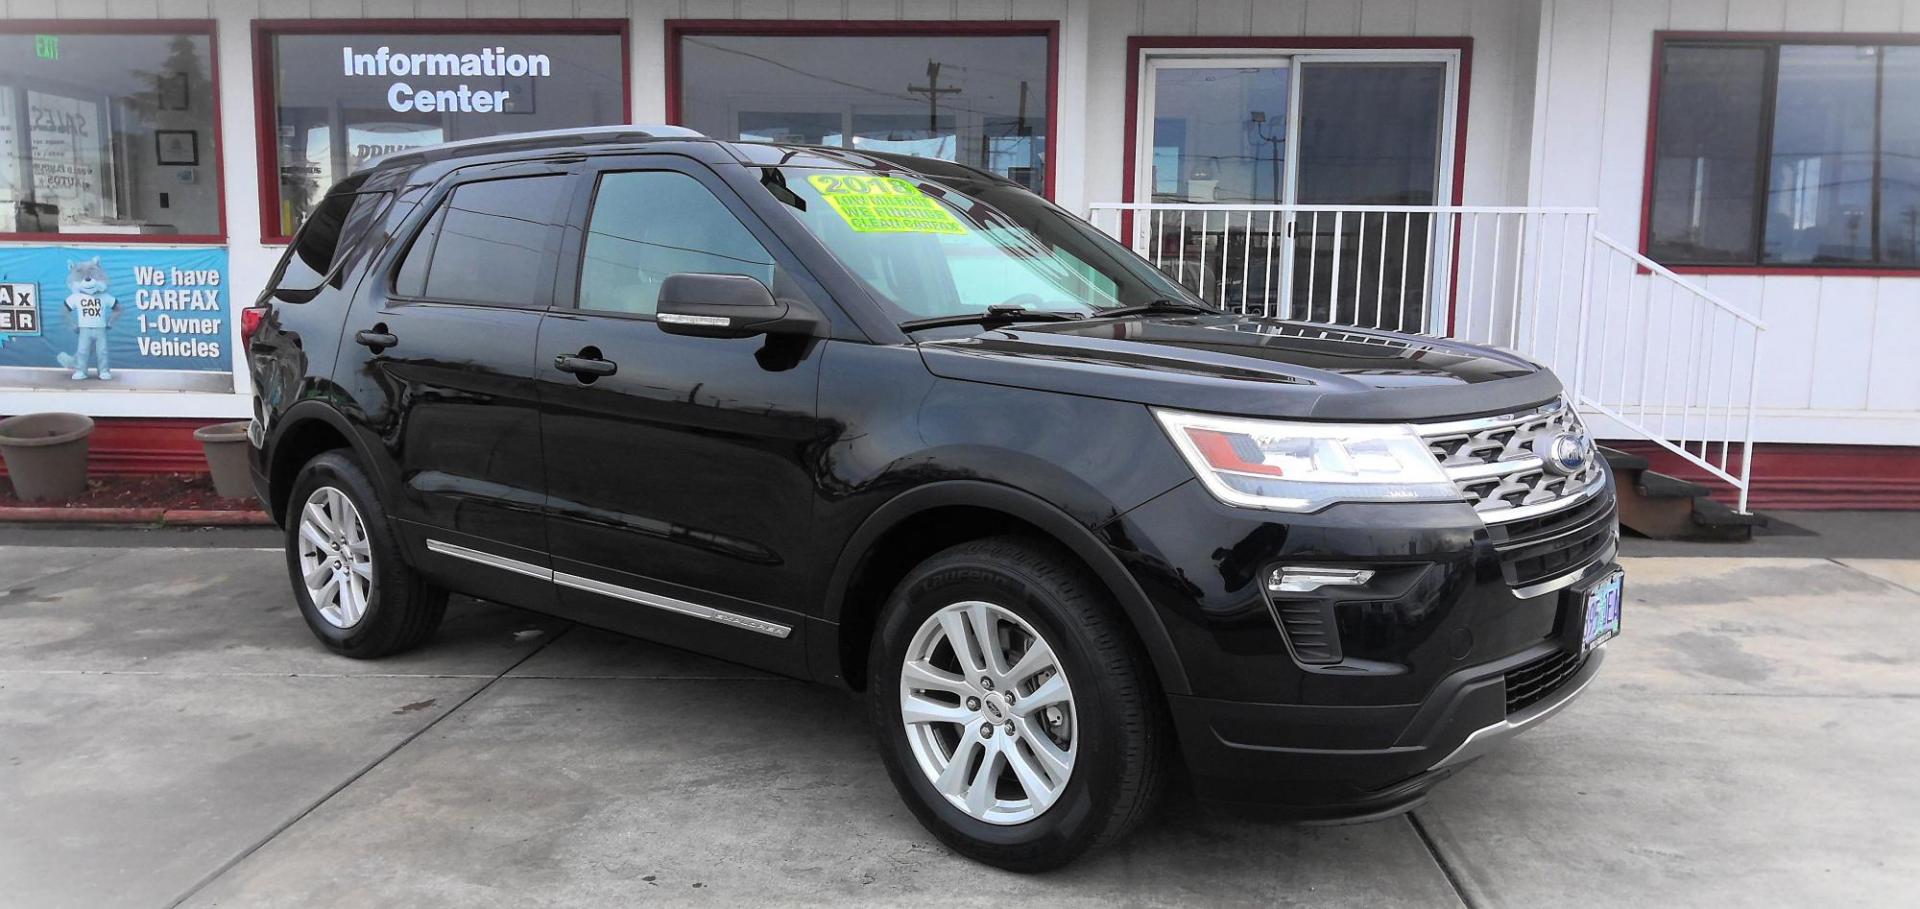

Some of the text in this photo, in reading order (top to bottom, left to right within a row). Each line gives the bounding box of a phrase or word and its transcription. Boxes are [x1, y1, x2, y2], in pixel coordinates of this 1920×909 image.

[343, 47, 550, 77] Information
[388, 82, 510, 113] Center
[850, 218, 902, 229] CLEAN
[134, 266, 220, 286] We have
[80, 298, 101, 307] CAR
[135, 289, 220, 311] CARFAX
[82, 308, 101, 317] FOX
[137, 313, 221, 334] 1-Owner
[137, 336, 220, 357] Vehicles
